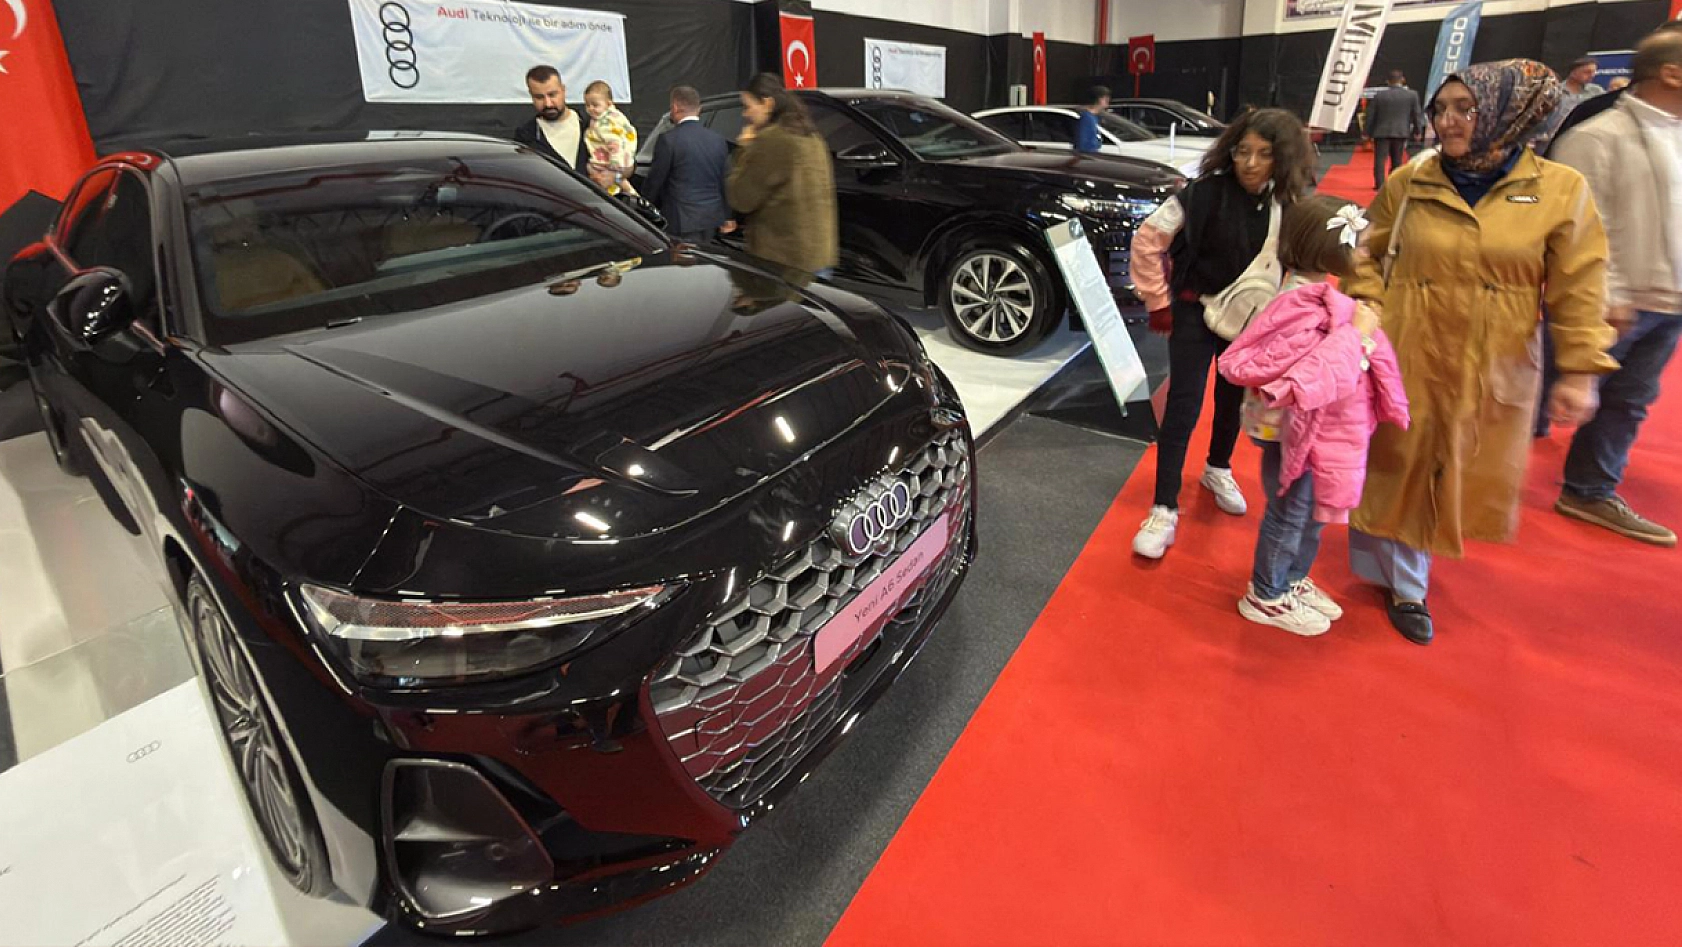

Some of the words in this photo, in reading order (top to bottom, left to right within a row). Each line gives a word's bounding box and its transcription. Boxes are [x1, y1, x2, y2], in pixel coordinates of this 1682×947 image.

[437, 6, 469, 19] Audi
[472, 9, 526, 26] Teknoloji
[543, 16, 558, 28] bir
[588, 21, 613, 32] önde
[1441, 17, 1469, 84] ECOO
[854, 596, 878, 622] Yeni
[880, 578, 896, 600] A6
[896, 551, 924, 582] Sedan
